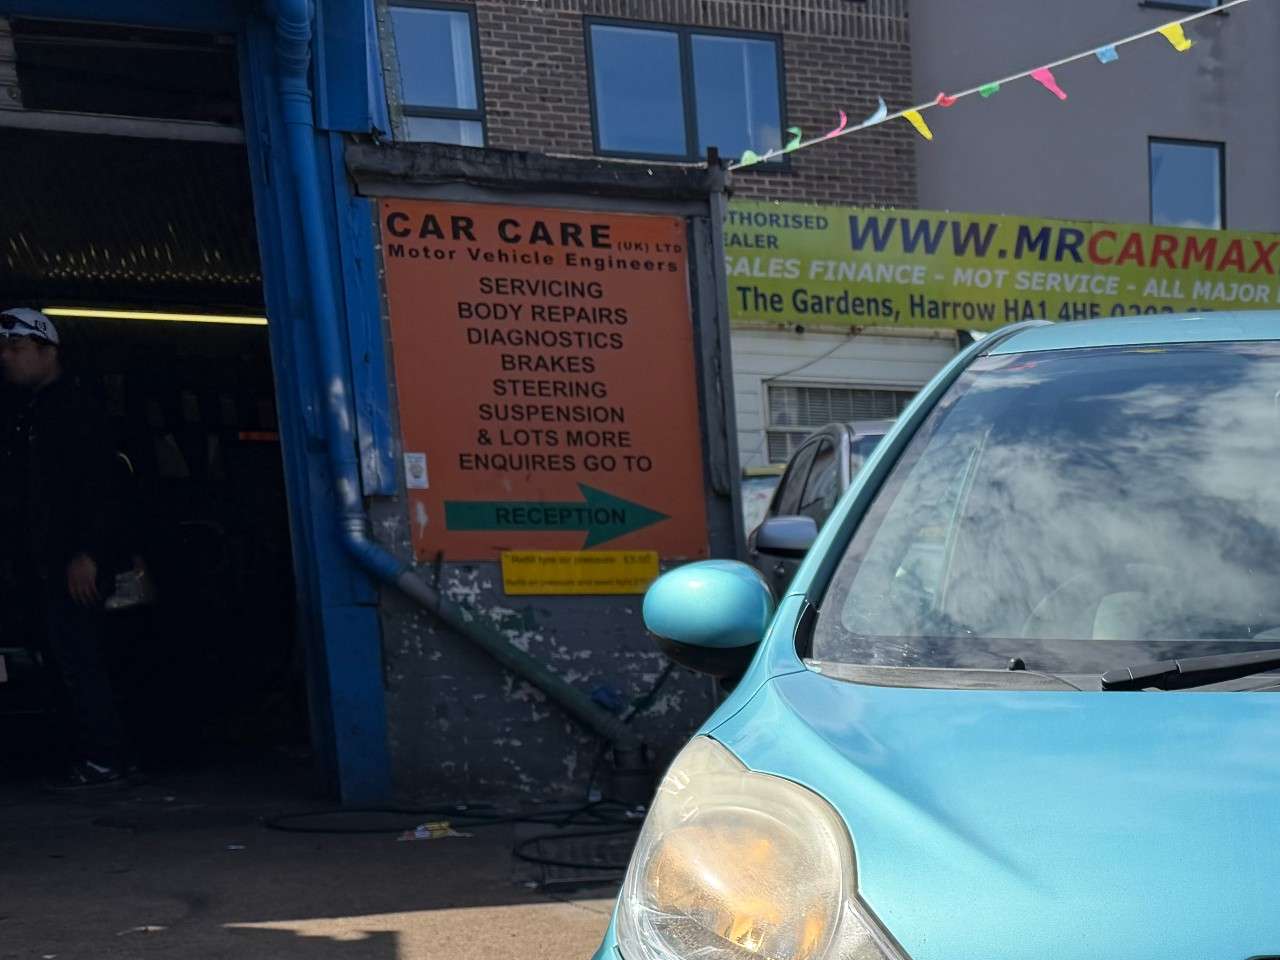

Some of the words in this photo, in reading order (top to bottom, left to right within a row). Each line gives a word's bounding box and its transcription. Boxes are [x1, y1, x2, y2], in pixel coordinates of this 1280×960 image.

[724, 211, 829, 230] THORISED
[386, 212, 477, 241] CAR
[497, 218, 612, 249] CARE
[617, 241, 650, 253] (UK)
[656, 243, 683, 254] LTD
[724, 233, 779, 249] ALER
[389, 244, 456, 260] Motor
[468, 247, 555, 266] Vehicle
[566, 252, 678, 274] Engineers
[480, 277, 603, 299] SERVICING
[725, 256, 801, 279] SALES
[809, 260, 926, 285] FINANCE
[953, 269, 1008, 289] MOT
[1015, 271, 1120, 296] SERVICE
[1143, 278, 1185, 299] ALL
[1192, 281, 1269, 302] MAJOR
[458, 302, 522, 322] BODY
[532, 304, 628, 325] REPAIRS
[737, 286, 783, 313] The
[792, 287, 901, 323] Gardens,
[910, 294, 996, 323] Harrow
[1004, 299, 1047, 321] HA1
[467, 327, 624, 350] DIAGNOSTICS
[501, 353, 595, 374] BRAKES
[493, 379, 608, 399] STEERING
[479, 404, 625, 425] SUSPENSION
[478, 429, 494, 446] &
[500, 429, 559, 448] LOTS
[567, 430, 632, 449] MORE
[459, 453, 576, 473] ENQUIRES
[584, 455, 617, 473] GO
[624, 455, 652, 473] TO
[496, 508, 626, 527] RECEPTION
